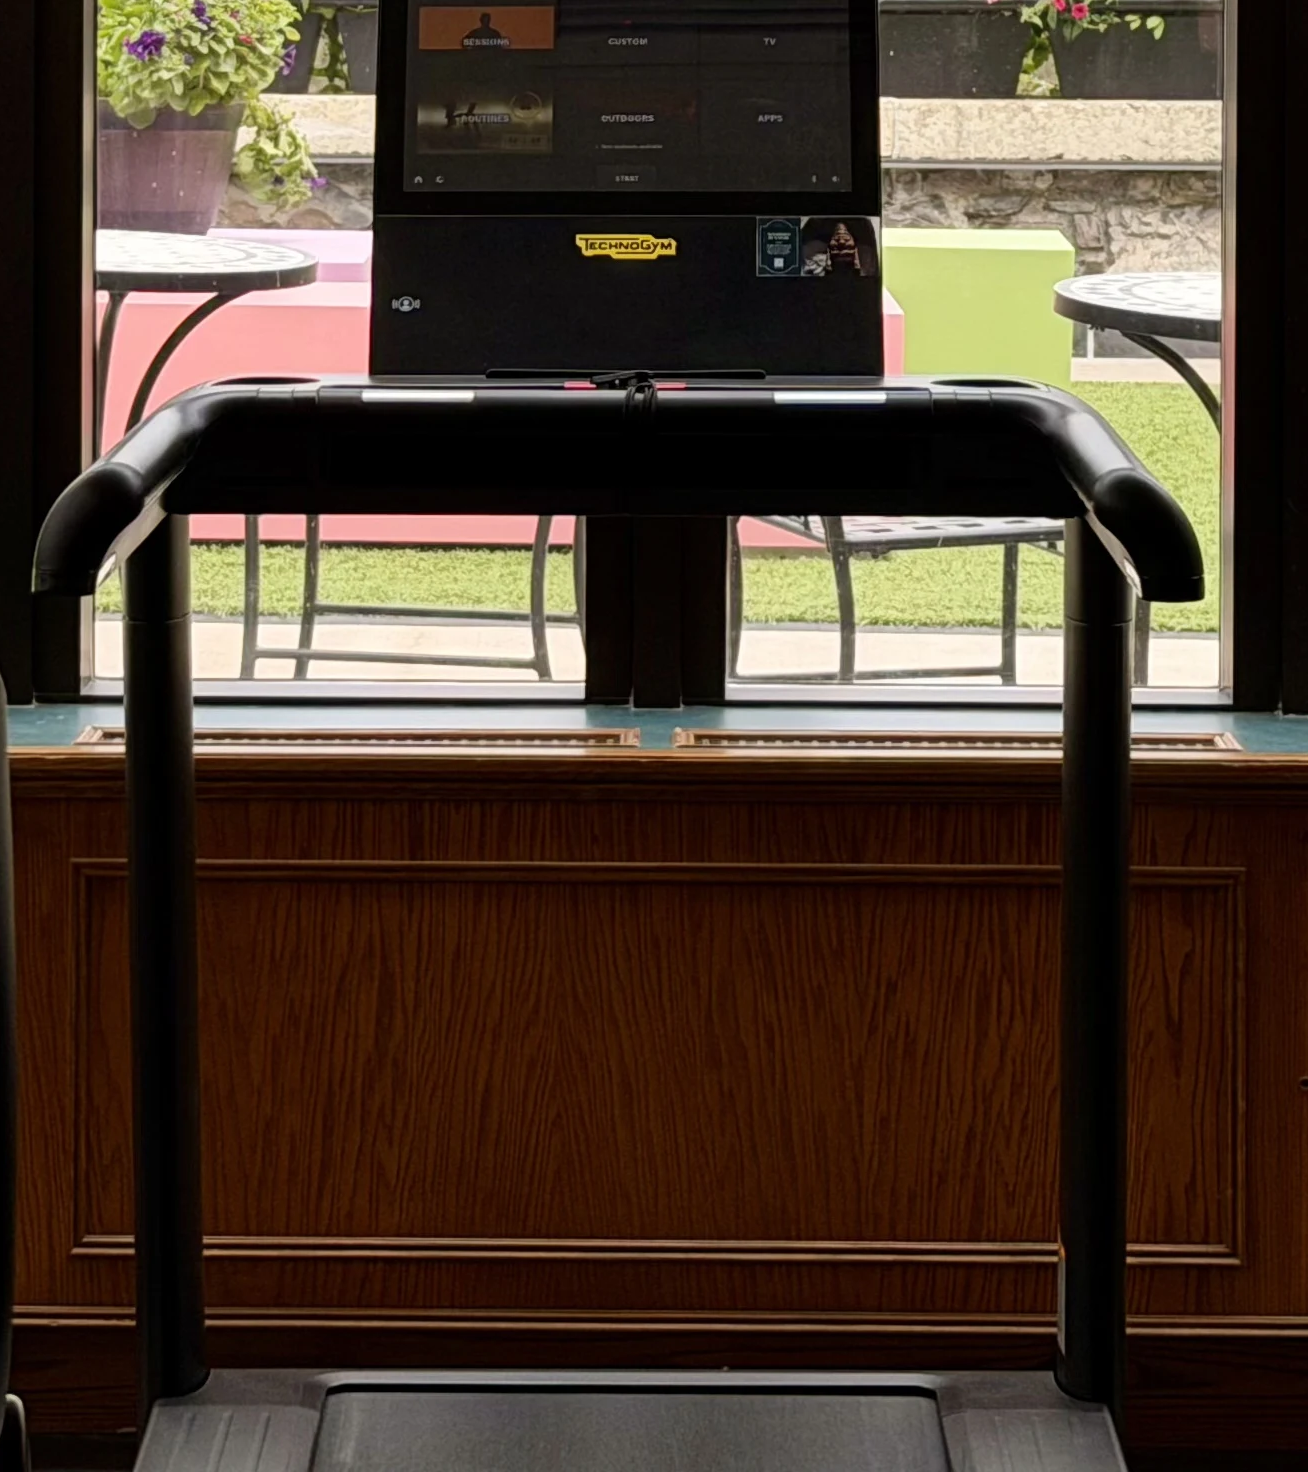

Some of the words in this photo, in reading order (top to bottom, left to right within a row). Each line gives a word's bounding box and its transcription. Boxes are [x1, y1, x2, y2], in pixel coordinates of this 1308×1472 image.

[463, 38, 510, 46] SESSIONS
[608, 37, 648, 46] CUSTOM
[763, 37, 776, 46] TV
[460, 114, 510, 123] ROUTINES
[601, 114, 655, 122] OUTDOORS
[758, 114, 783, 122] APPS
[578, 237, 672, 255] TECHNOGYM
